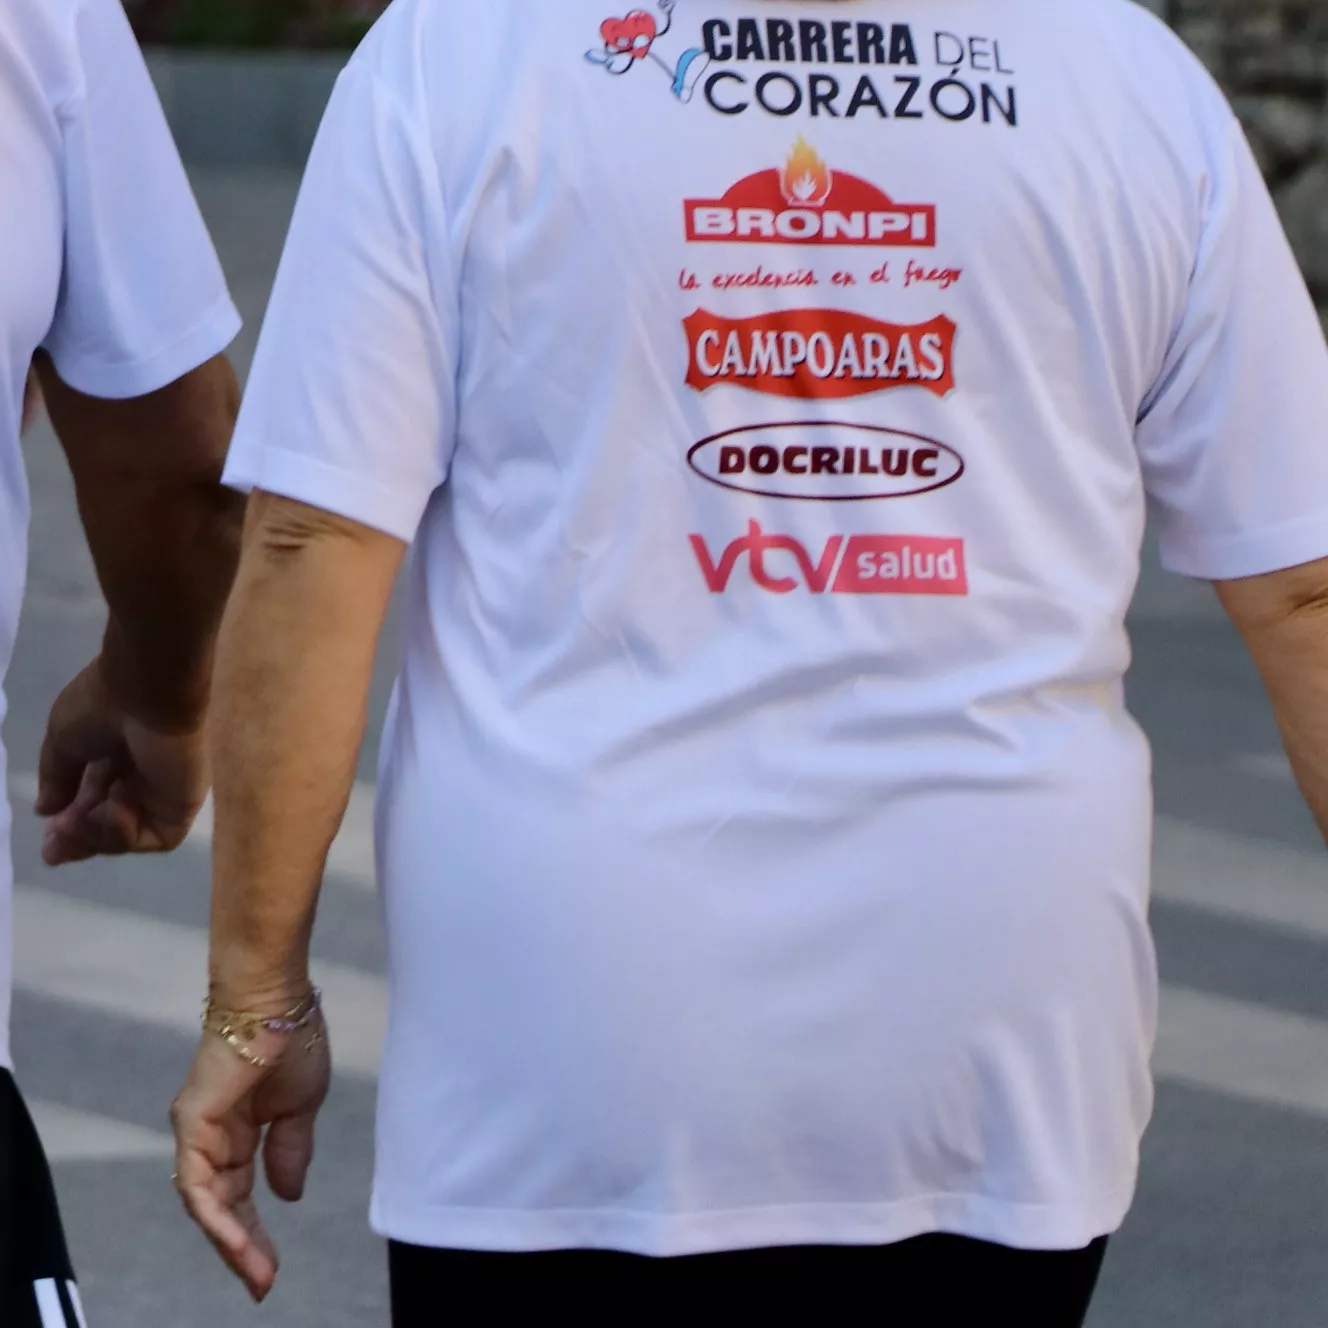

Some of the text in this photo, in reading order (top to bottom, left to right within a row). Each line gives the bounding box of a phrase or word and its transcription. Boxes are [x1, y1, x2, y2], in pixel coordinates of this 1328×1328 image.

[702, 17, 1015, 74] CARRERA DEL
[704, 67, 1019, 127] CORAZÓN
[693, 206, 928, 241] BRONPI
[678, 257, 964, 292] la excelencia en el fuego
[695, 328, 946, 381] CAMPOARAS
[718, 444, 940, 477] DOCRILUC
[856, 544, 958, 581] salud
